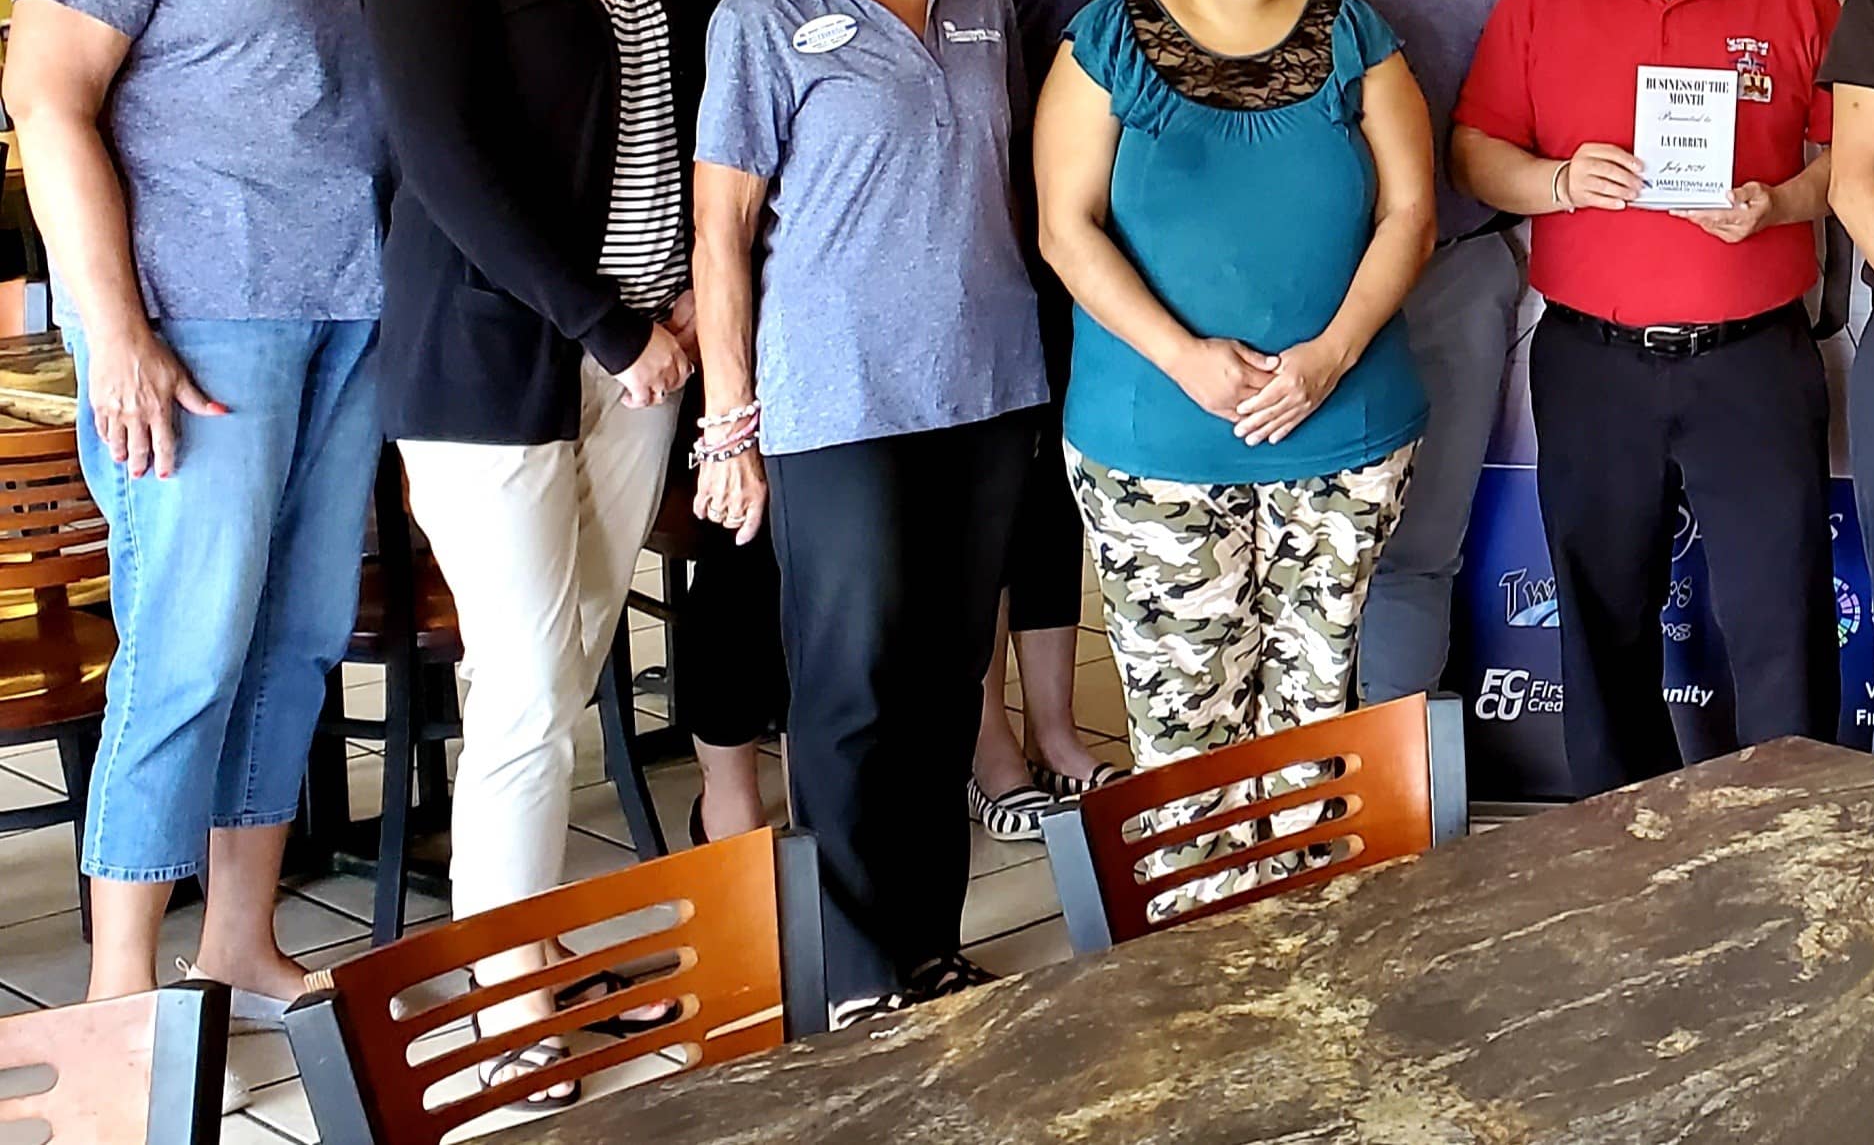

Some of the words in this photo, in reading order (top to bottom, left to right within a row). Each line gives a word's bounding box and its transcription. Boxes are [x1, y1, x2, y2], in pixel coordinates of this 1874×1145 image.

[1646, 77, 1693, 91] BUSINESS
[1694, 80, 1708, 93] OF
[1708, 81, 1729, 94] THE
[1669, 92, 1704, 106] MONTH
